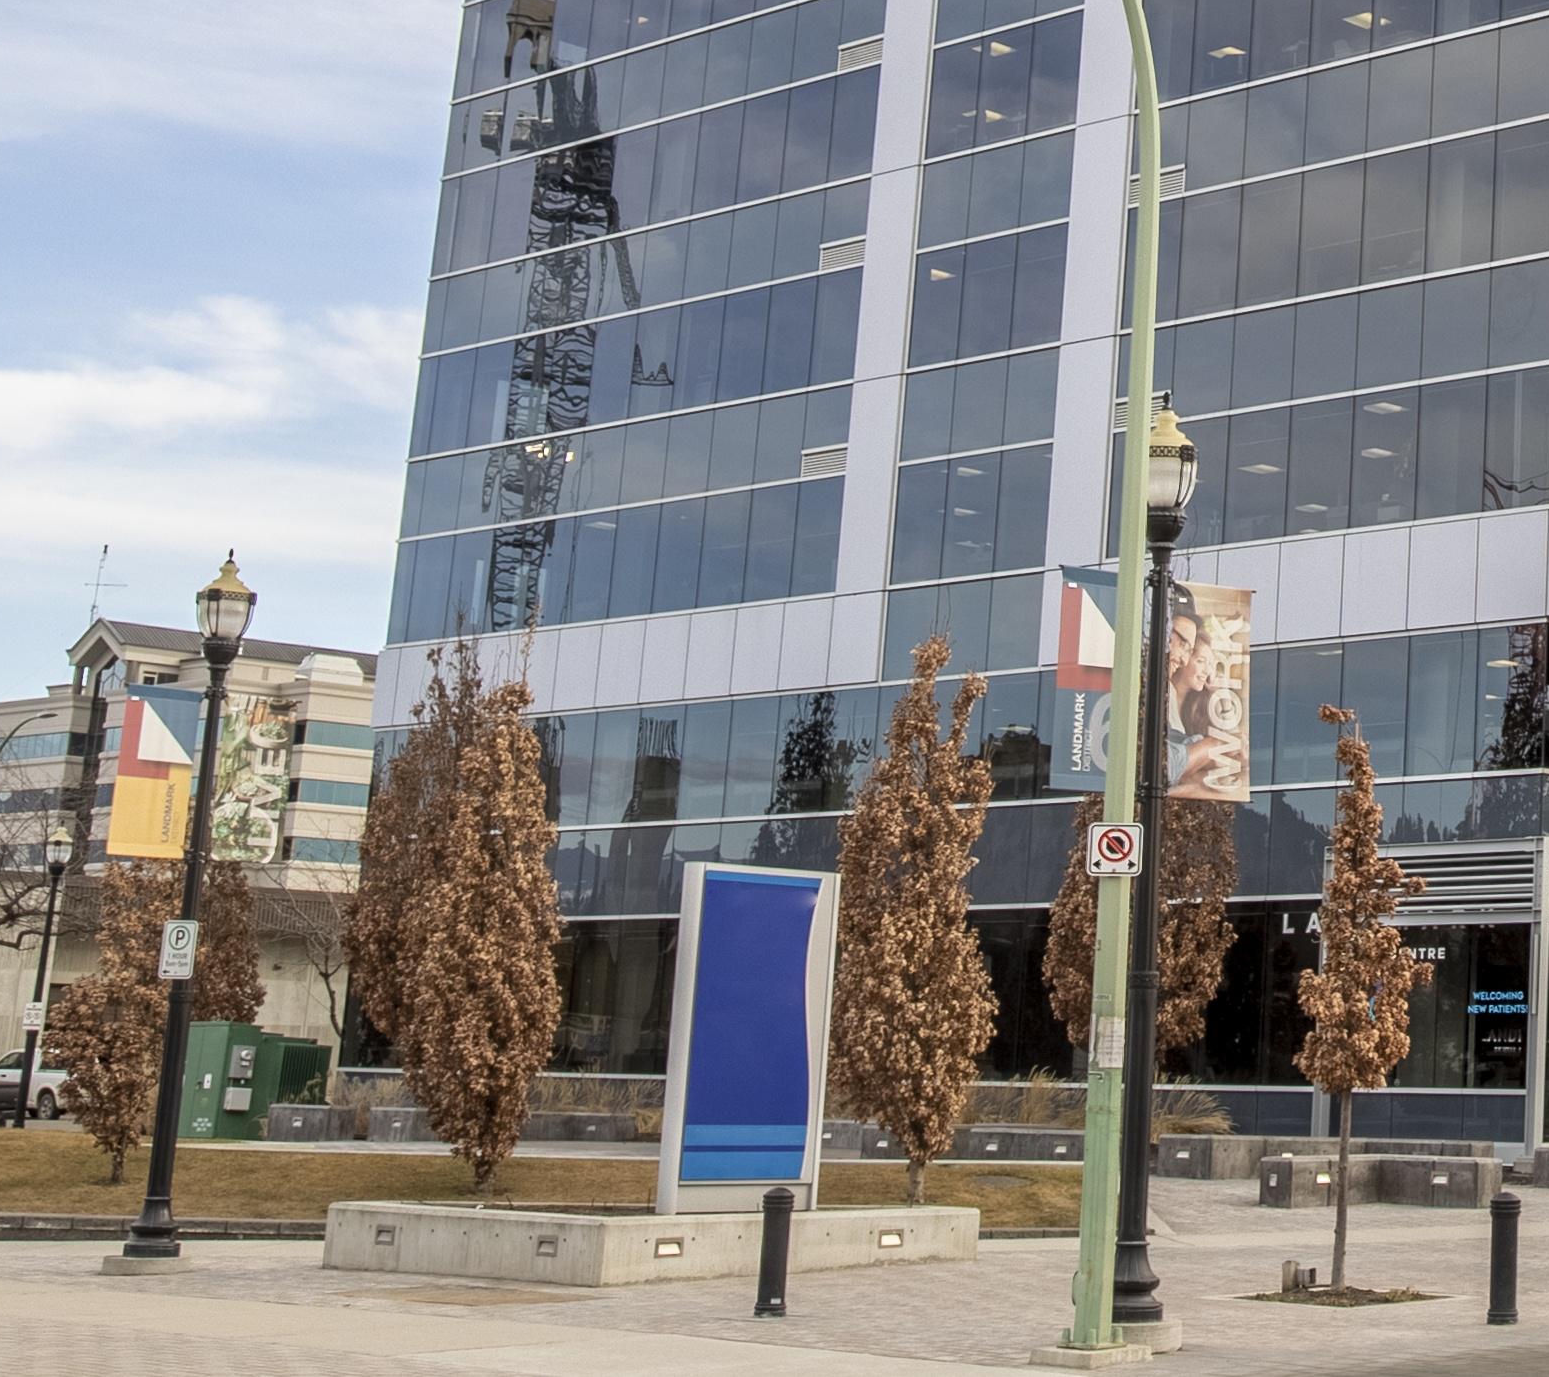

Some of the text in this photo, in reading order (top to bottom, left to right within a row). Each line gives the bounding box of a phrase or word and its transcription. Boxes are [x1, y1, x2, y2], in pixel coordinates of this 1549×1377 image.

[1071, 692, 1086, 771] LANDMARK
[1203, 613, 1244, 790] WORK
[161, 782, 176, 843] LANDMARK
[1467, 1005, 1487, 1013] NEW
[1473, 991, 1524, 1001] WELCOMING
